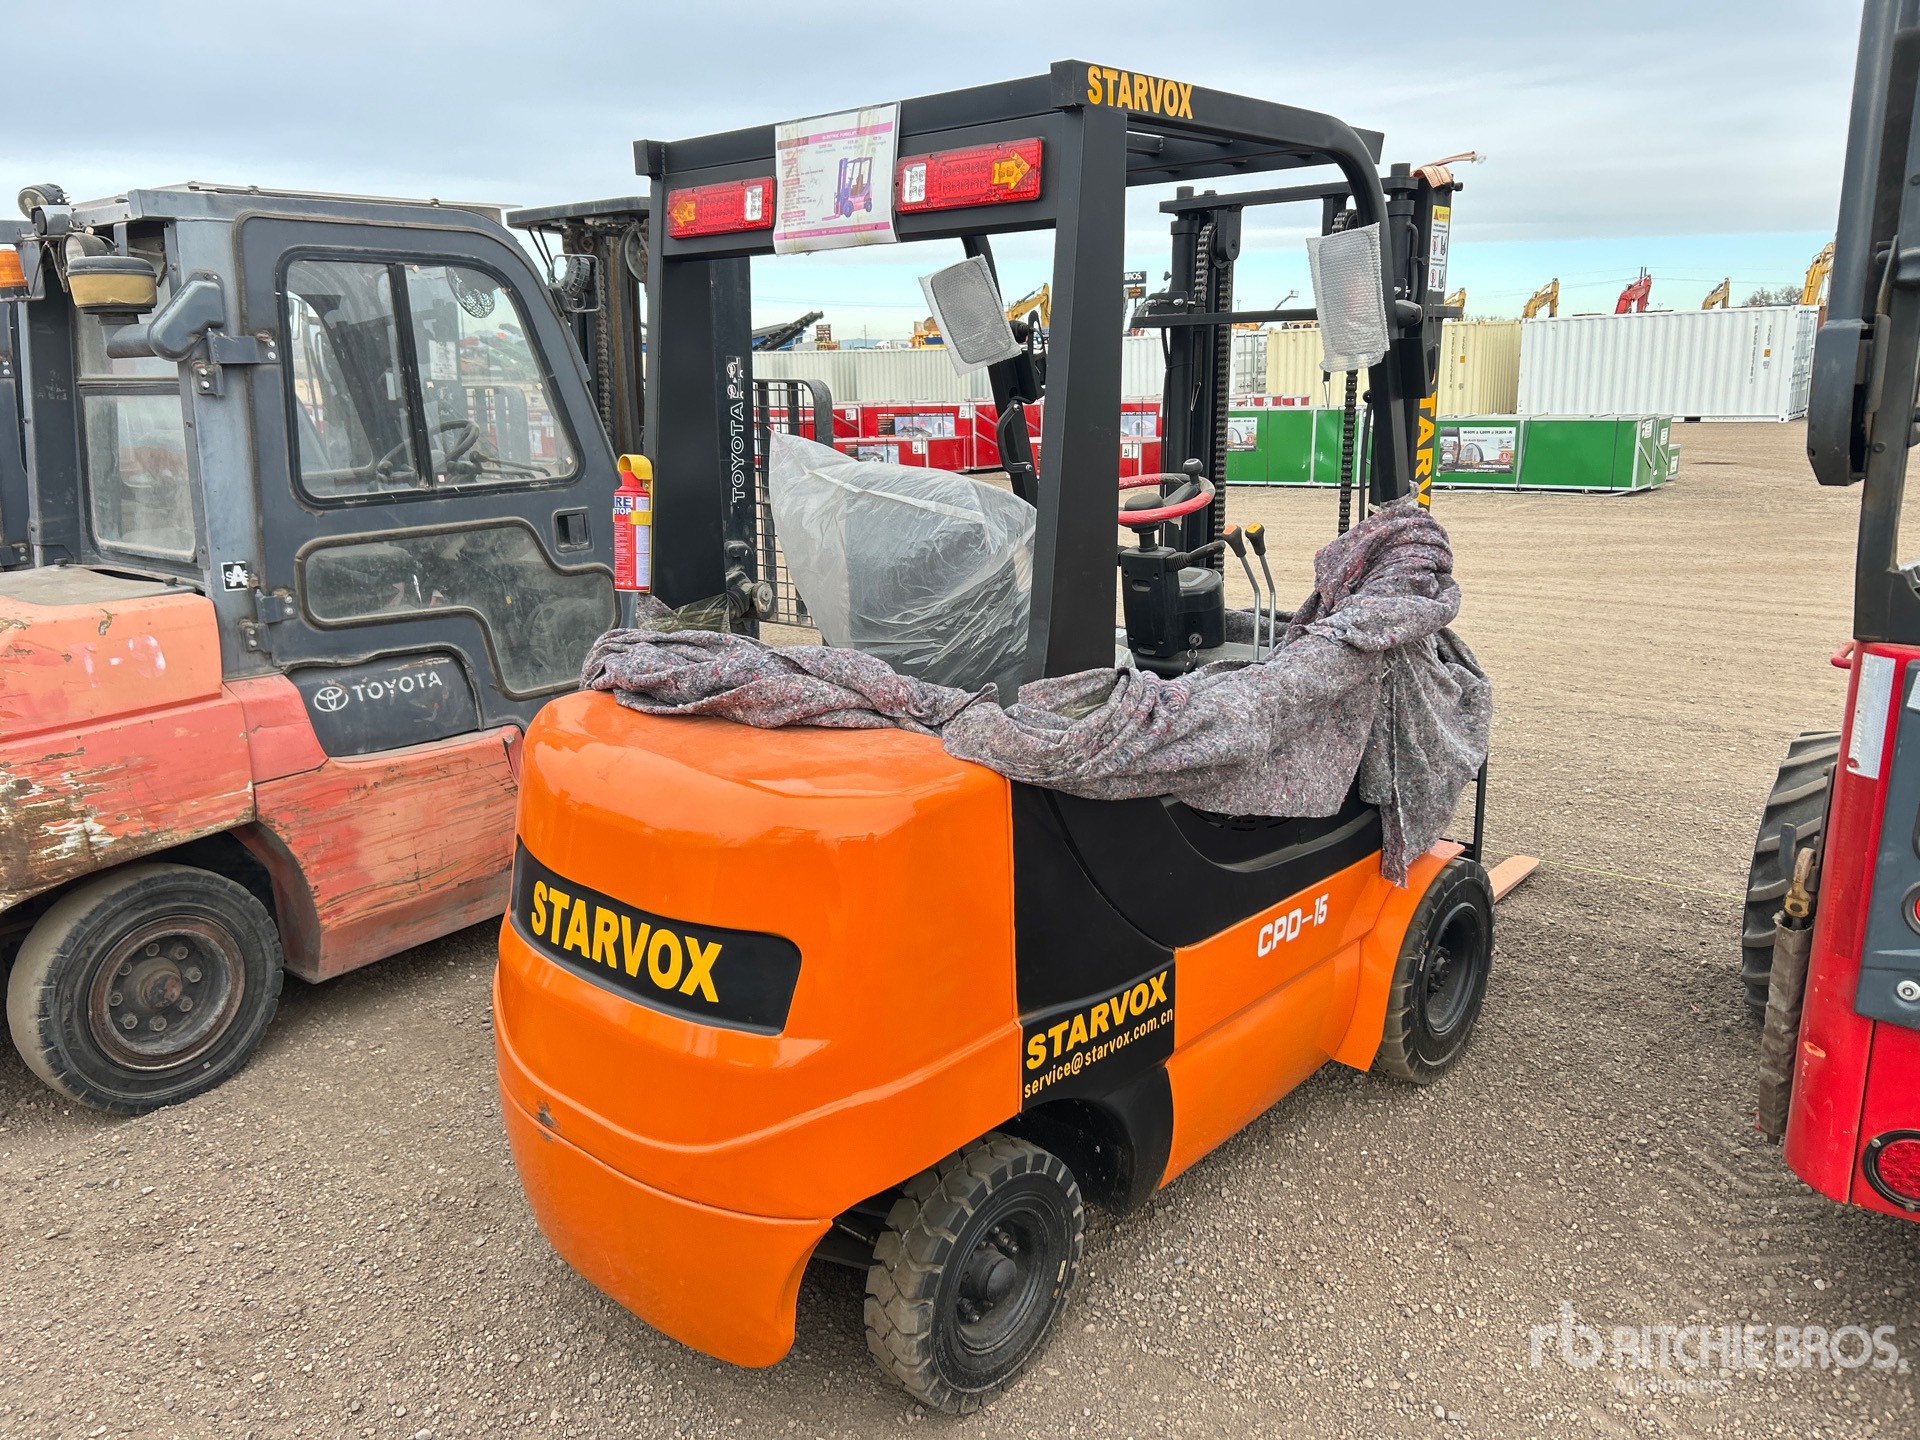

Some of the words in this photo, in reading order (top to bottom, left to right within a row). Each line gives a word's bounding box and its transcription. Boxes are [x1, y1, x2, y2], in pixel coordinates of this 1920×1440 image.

[1087, 65, 1193, 120] STARVOX
[730, 402, 745, 503] TOYOTA
[1415, 374, 1437, 508] TARV
[615, 496, 632, 507] RE
[352, 671, 443, 702] TOYOTA
[531, 880, 723, 1003] STARVOX
[1257, 893, 1329, 958] CPD-15
[1024, 1008, 1173, 1099] service@starvox.com.cn
[1025, 970, 1168, 1070] STARVOX
